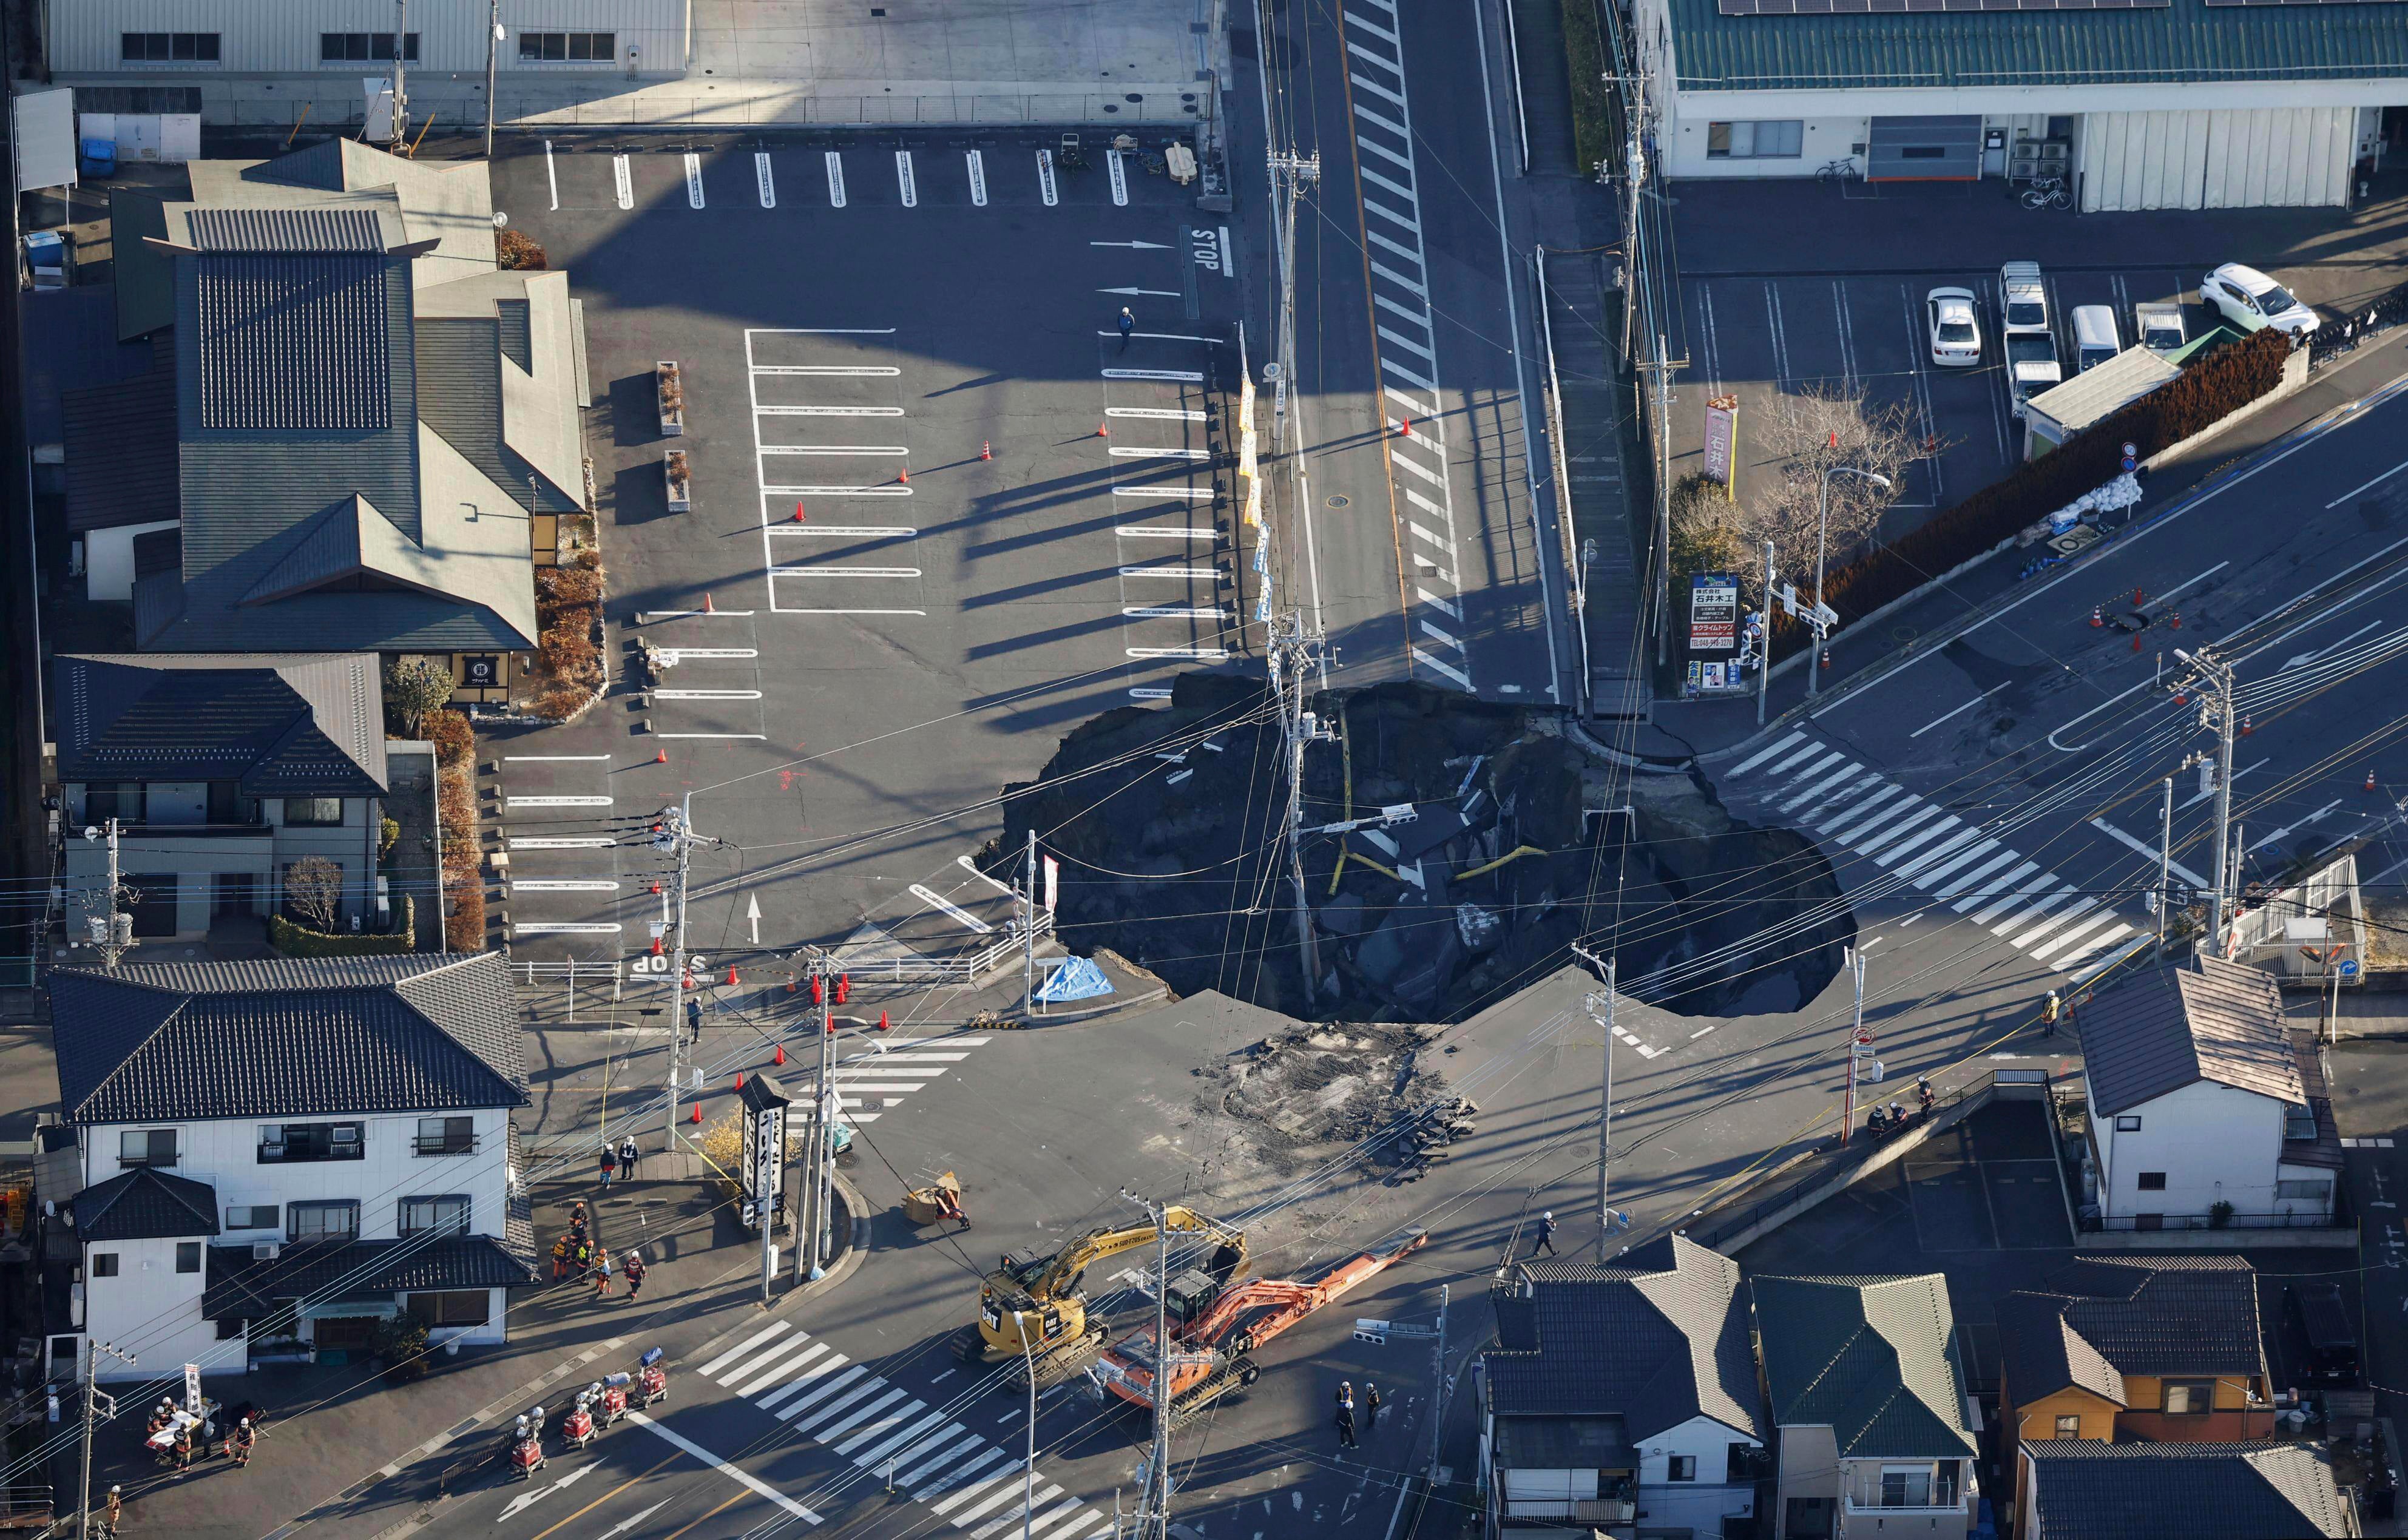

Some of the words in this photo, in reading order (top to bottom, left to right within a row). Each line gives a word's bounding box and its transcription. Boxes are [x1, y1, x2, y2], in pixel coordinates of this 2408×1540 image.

[1192, 230, 1219, 270] STOP
[632, 954, 706, 973] SOP
[982, 1306, 998, 1330] CAT
[1046, 1317, 1057, 1328] CAT
